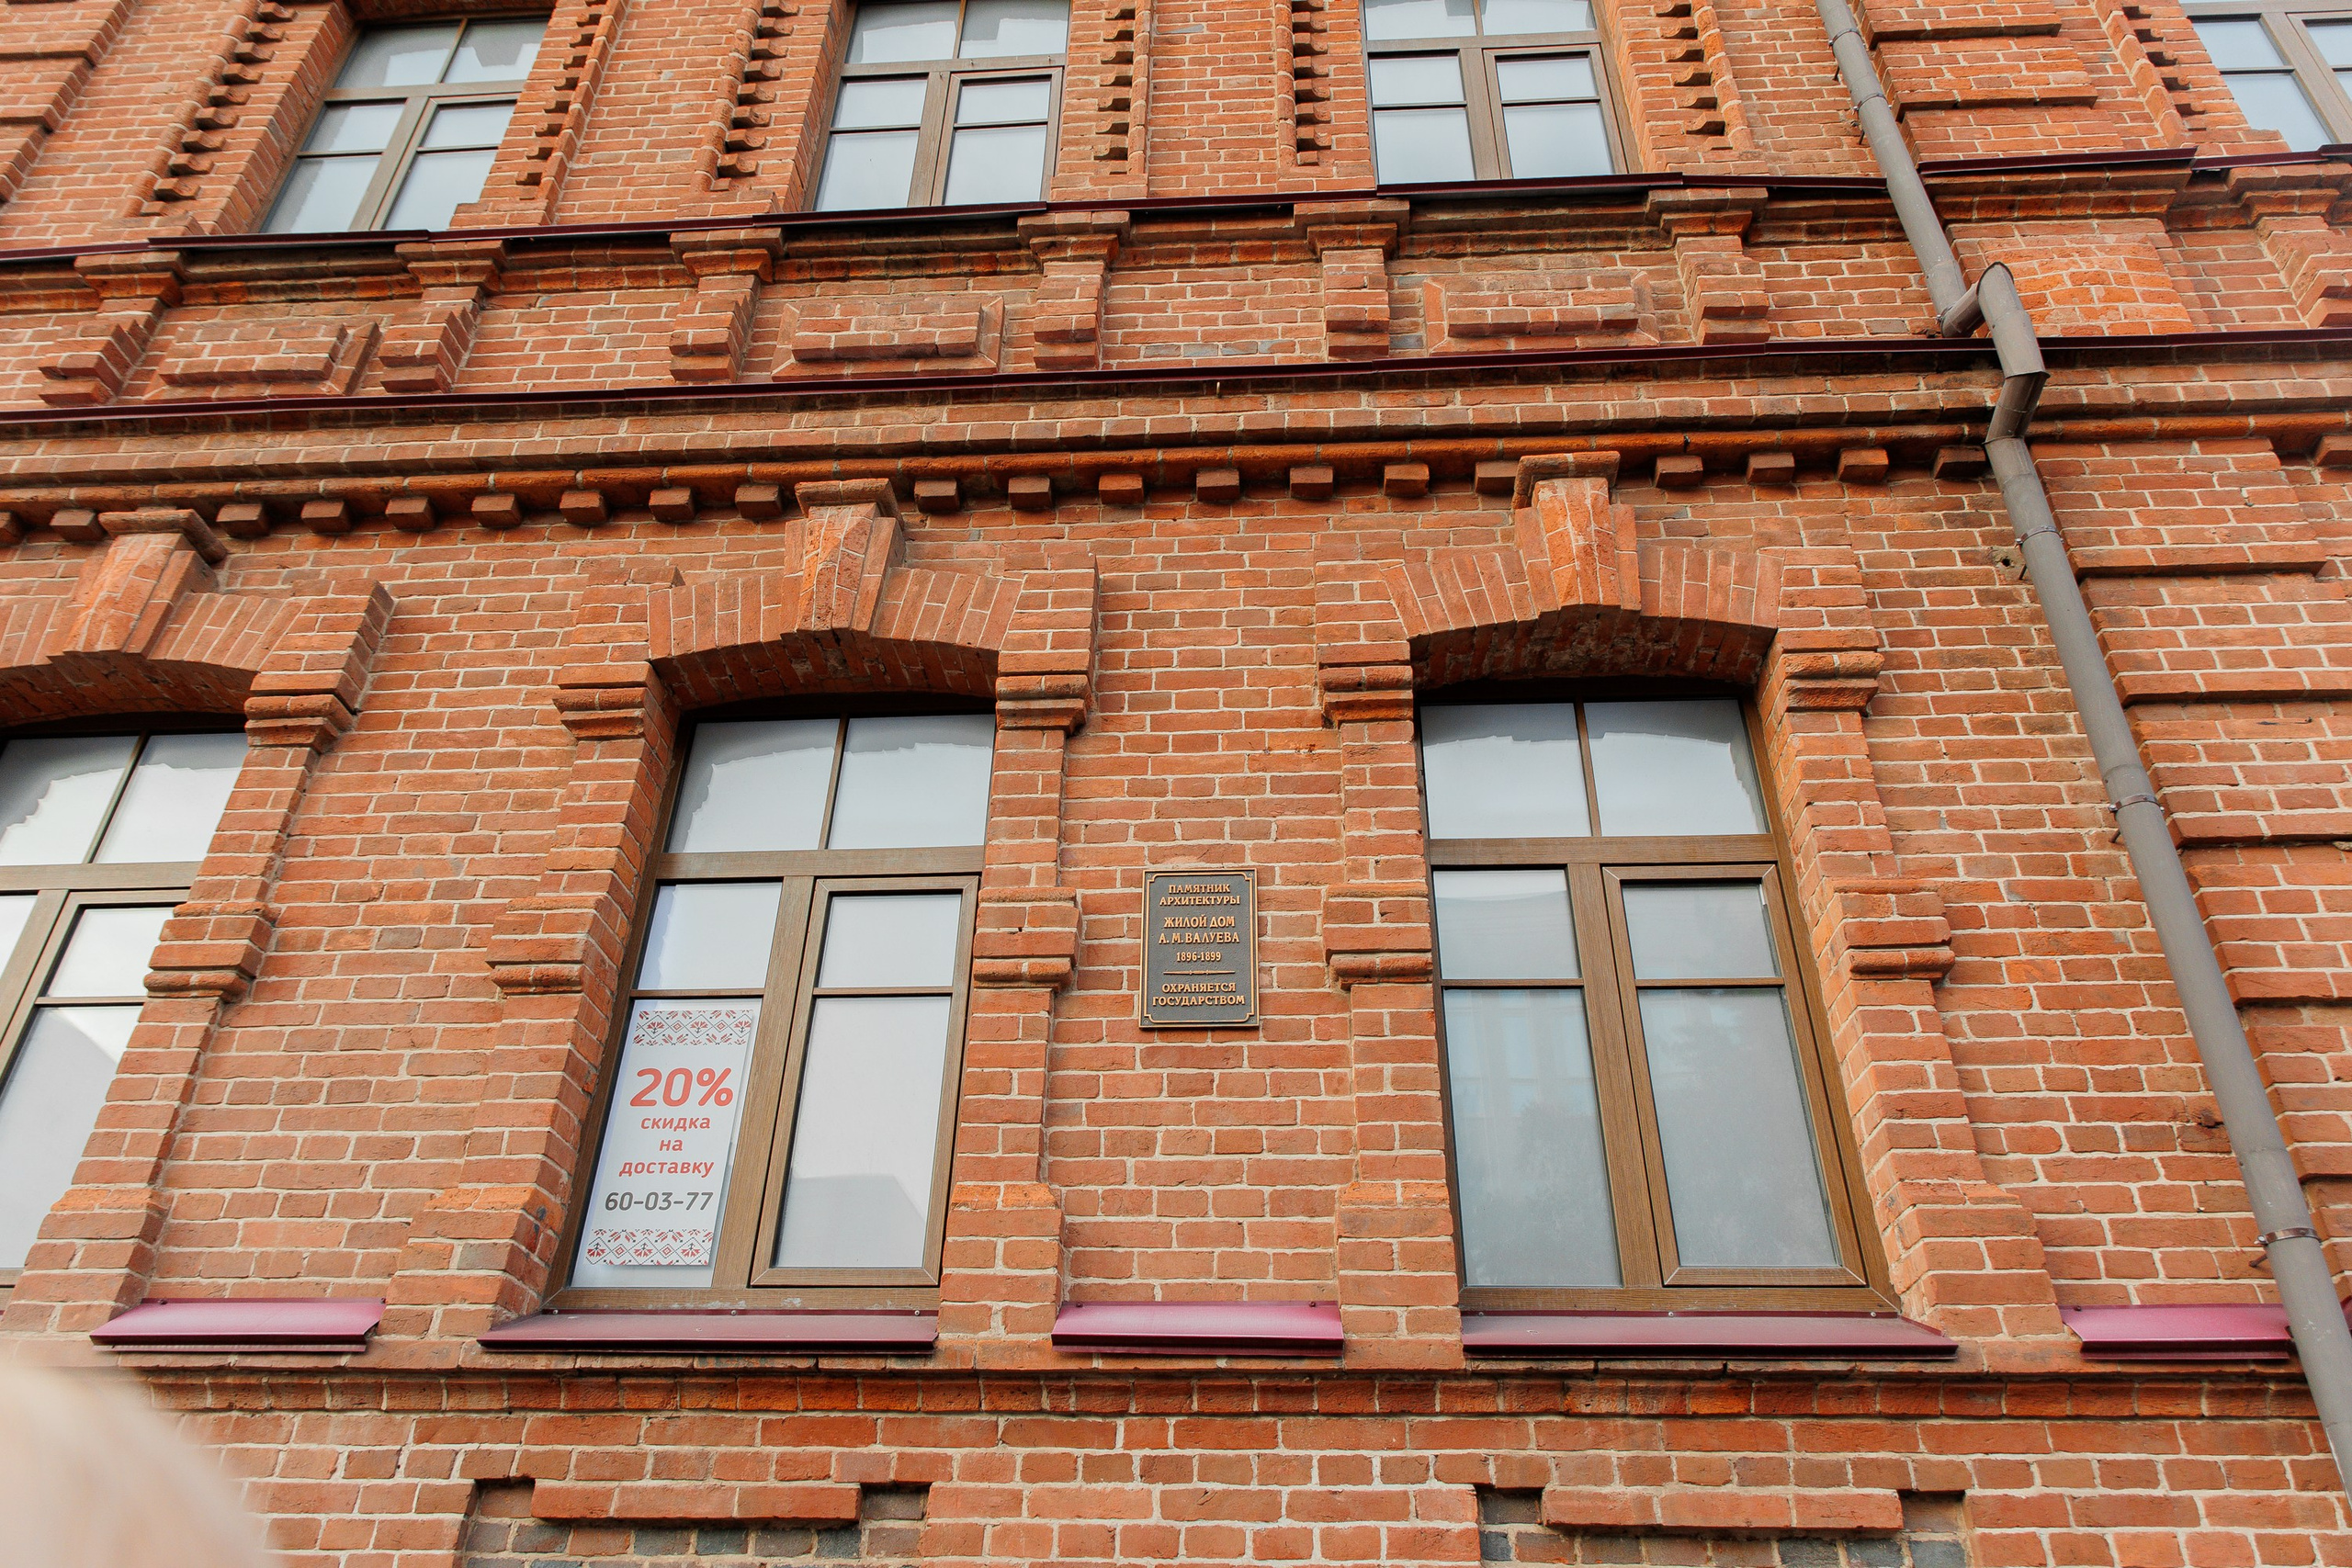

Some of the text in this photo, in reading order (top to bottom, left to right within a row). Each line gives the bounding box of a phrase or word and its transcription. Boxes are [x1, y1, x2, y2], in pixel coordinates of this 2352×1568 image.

[1168, 884, 1231, 895] ПАМЯТНИК
[1159, 895, 1240, 907] АРХИТЕКТУРЫ
[1163, 914, 1236, 929] ЖИЛОЙ ДОМ
[1185, 931, 1240, 944] ВАЛУЕВА
[1176, 951, 1222, 963] 1896-1899
[1161, 982, 1237, 994] ОХРАНЯЕТСЯ
[1151, 994, 1246, 1007] ГОСУДАРСТВОМ
[629, 1066, 734, 1108] 20%
[639, 1115, 711, 1132] скидка
[658, 1138, 684, 1152] на
[618, 1160, 715, 1179] доставку
[605, 1191, 714, 1212] 60-03-77
